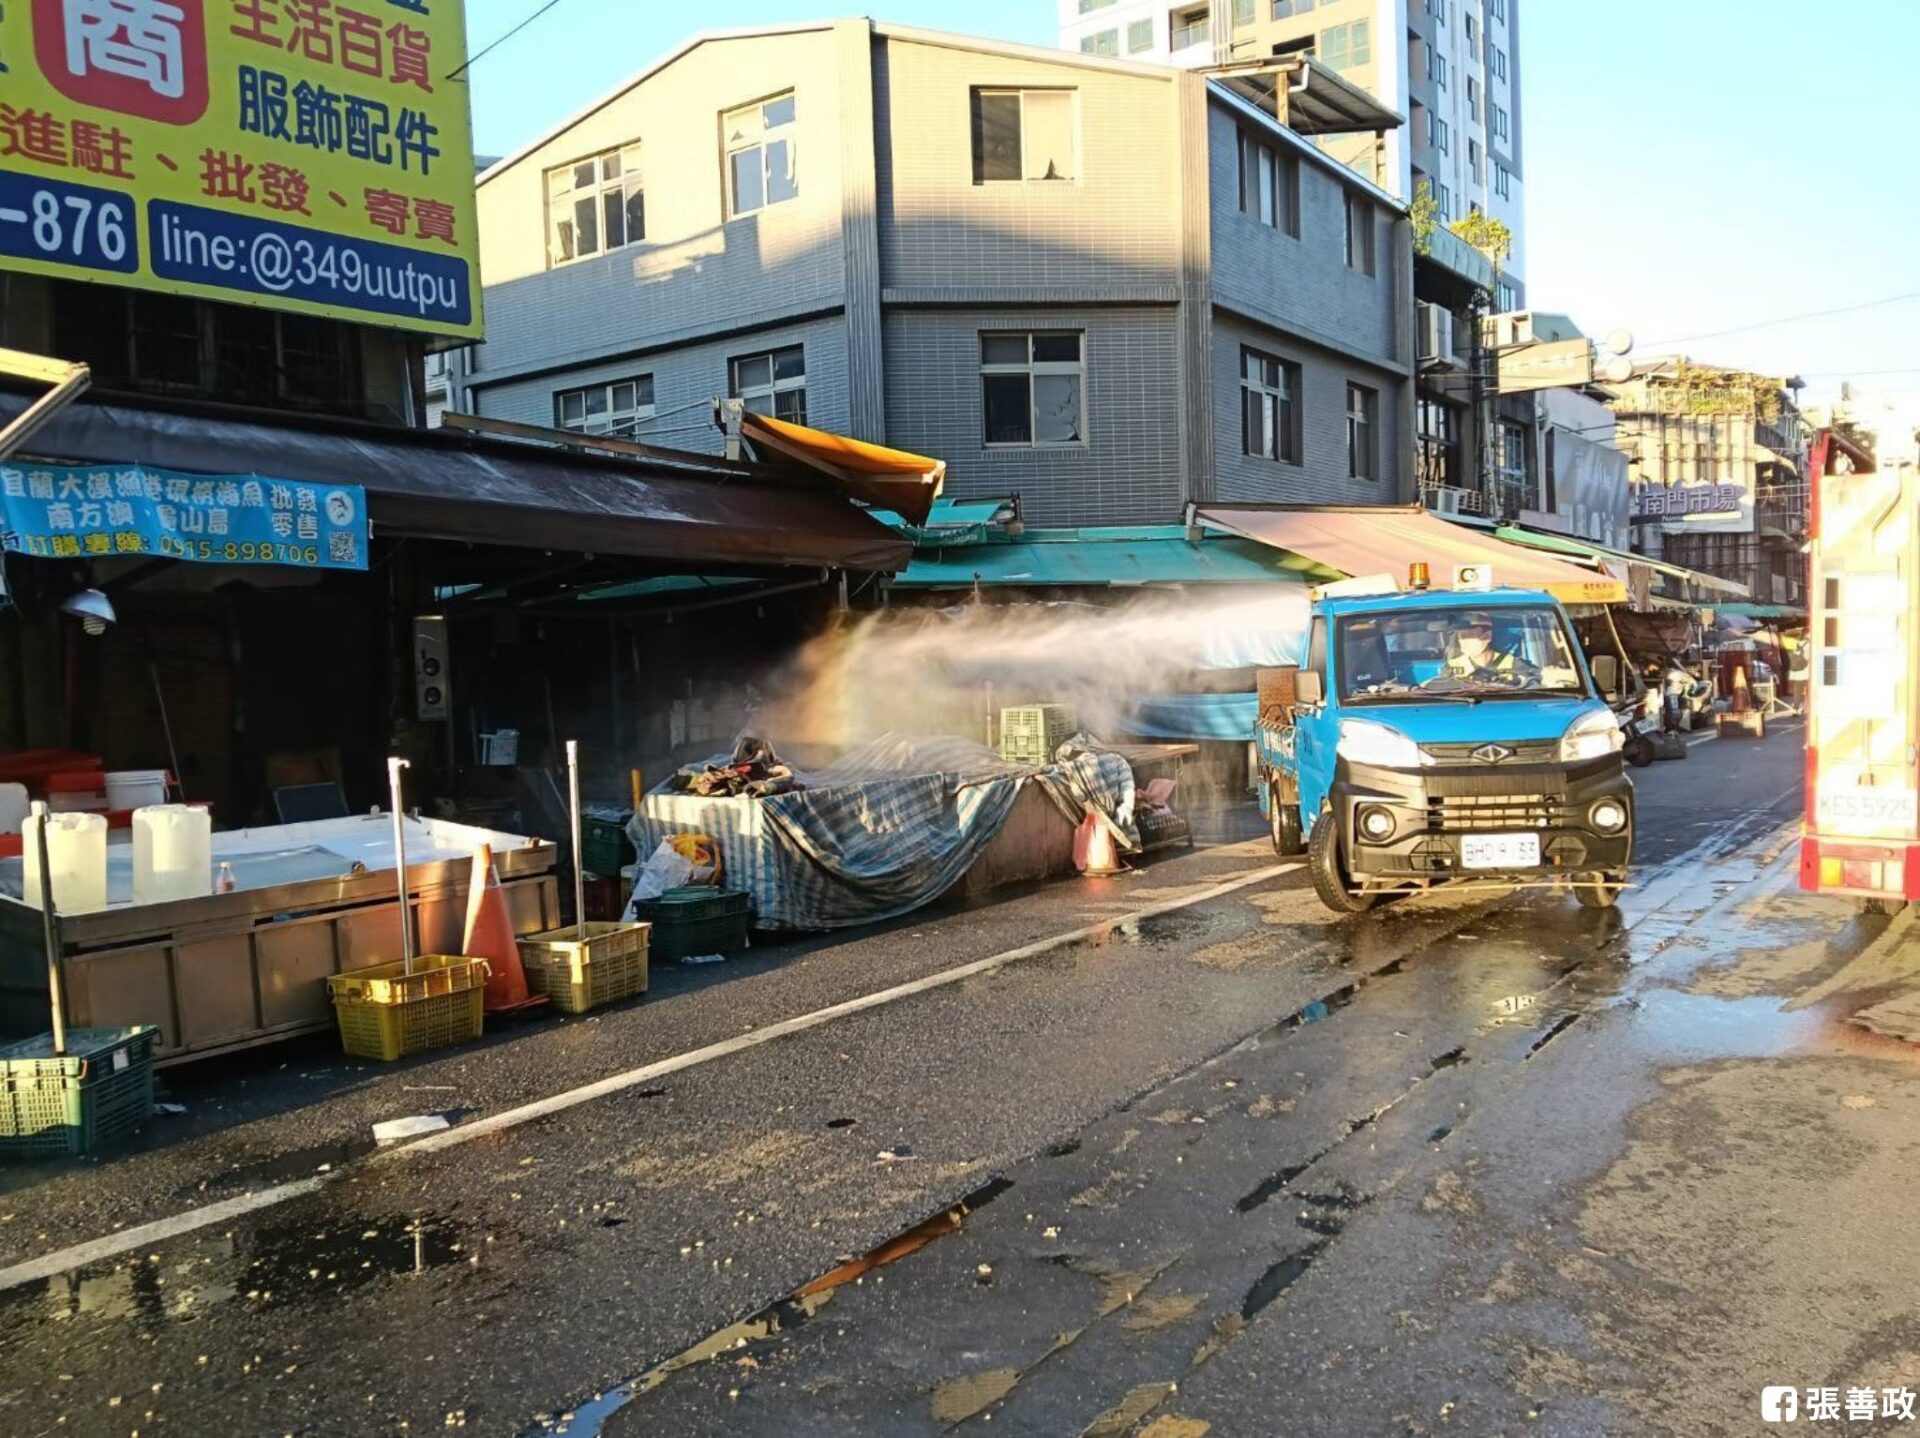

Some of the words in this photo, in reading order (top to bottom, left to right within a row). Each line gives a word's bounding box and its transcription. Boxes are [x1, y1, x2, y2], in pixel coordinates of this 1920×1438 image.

[62, 0, 186, 99] 商
[230, 0, 434, 94] 生活百貨
[238, 64, 441, 176] 服飾配件
[161, 213, 458, 315] line:@349uutpu
[1645, 486, 1736, 516] 南門市場
